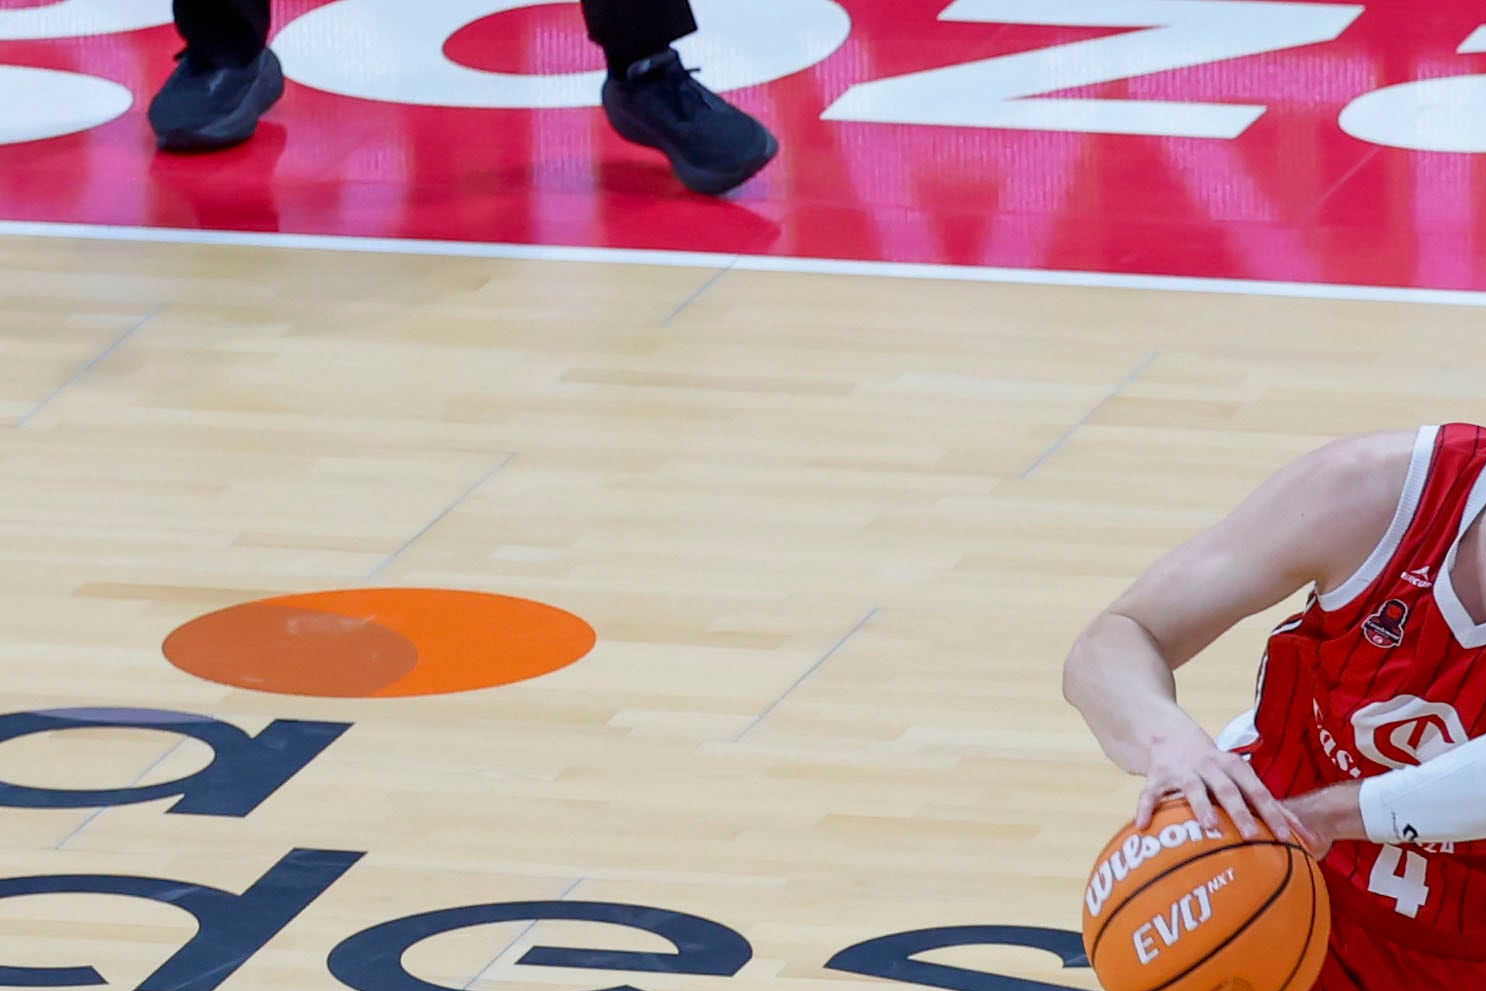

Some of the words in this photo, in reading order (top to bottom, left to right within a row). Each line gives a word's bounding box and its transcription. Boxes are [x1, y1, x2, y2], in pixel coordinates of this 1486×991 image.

[1132, 885, 1213, 966] EVO
[1207, 866, 1236, 895] NXT
[1367, 843, 1430, 918] 4
